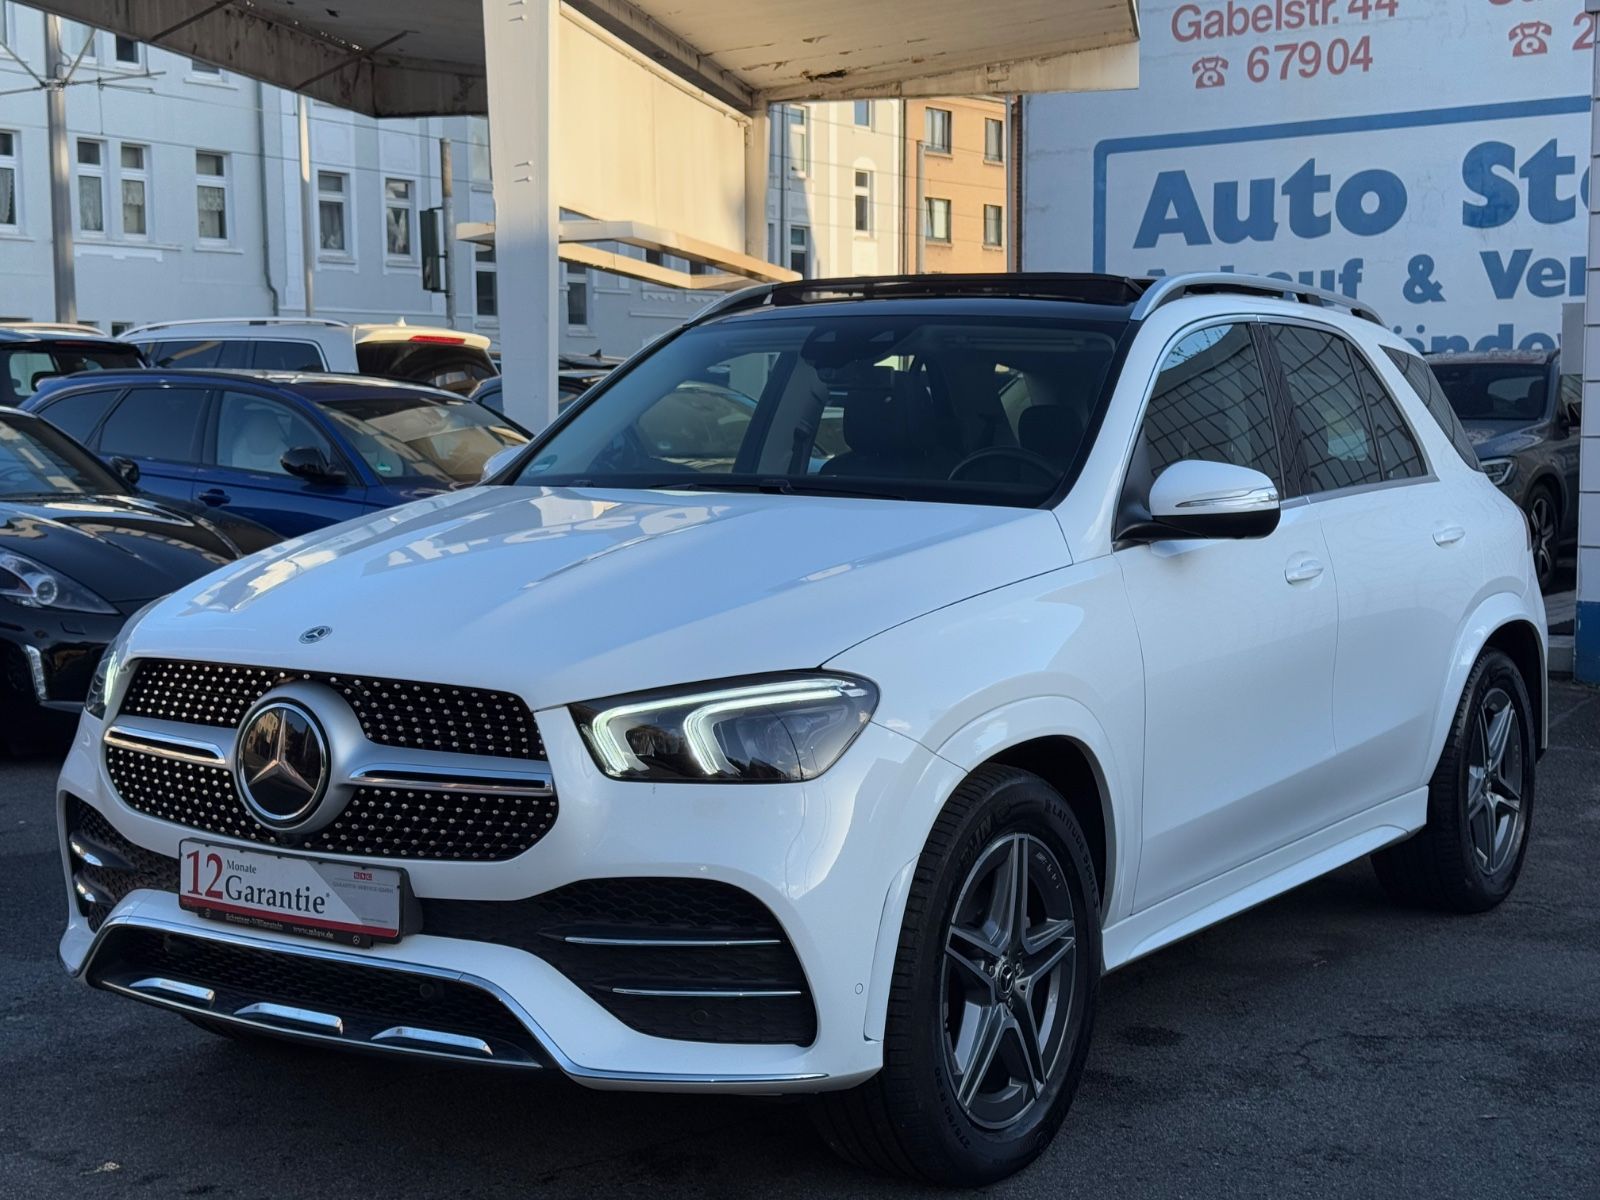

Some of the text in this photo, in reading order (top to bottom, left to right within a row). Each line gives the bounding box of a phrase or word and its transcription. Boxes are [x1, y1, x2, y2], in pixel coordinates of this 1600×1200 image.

[1171, 0, 1338, 42] Gabelstr.
[1246, 35, 1374, 84] 67904
[1133, 138, 1590, 249] Auto St
[1402, 254, 1446, 302] &
[186, 850, 224, 900] 12
[226, 859, 257, 875] Monate
